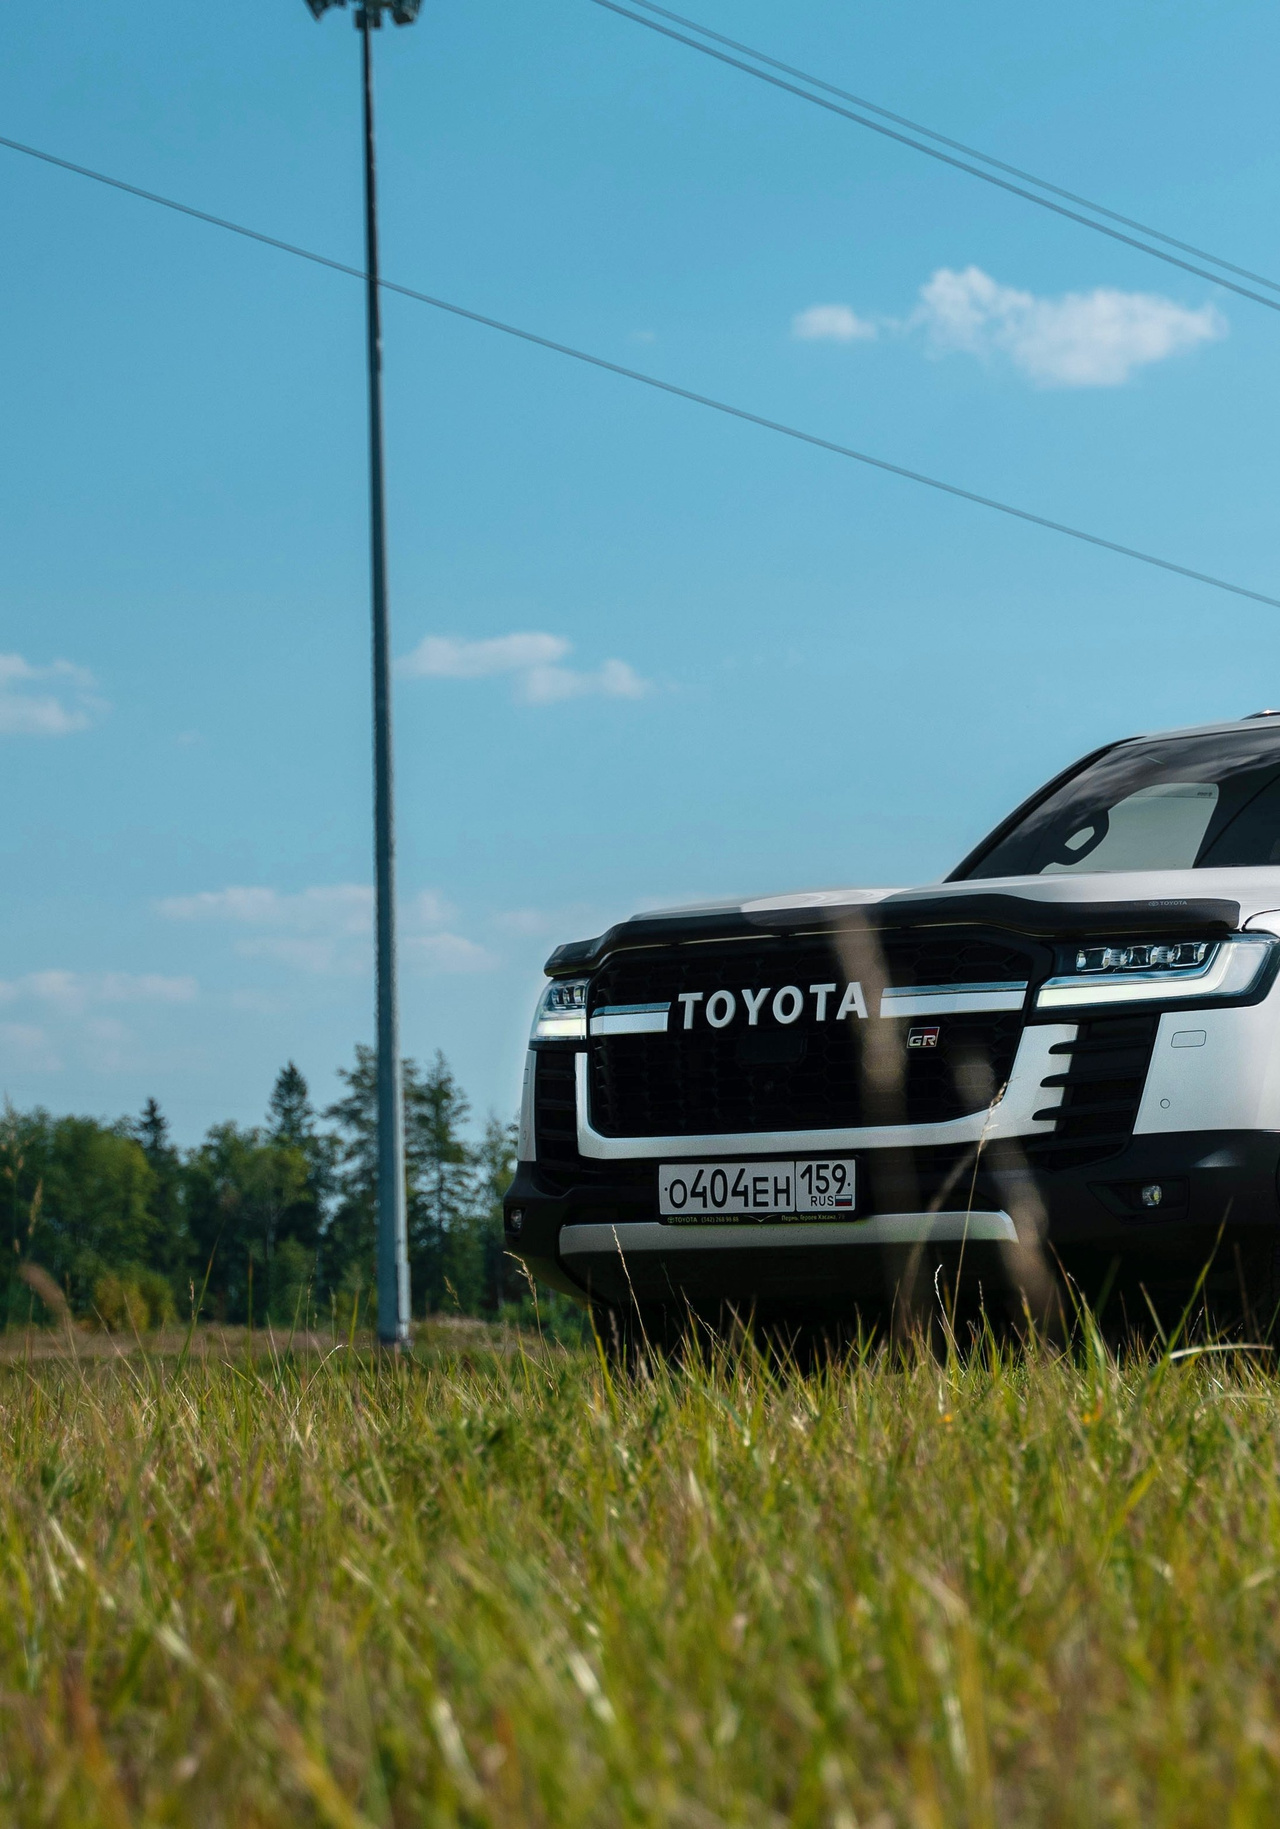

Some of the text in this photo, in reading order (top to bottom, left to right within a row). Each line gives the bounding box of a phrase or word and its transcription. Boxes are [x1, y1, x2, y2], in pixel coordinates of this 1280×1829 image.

[677, 981, 869, 1030] TOYOTA
[909, 1034, 936, 1047] GR
[800, 1163, 847, 1195] 159
[810, 1195, 834, 1206] RUS
